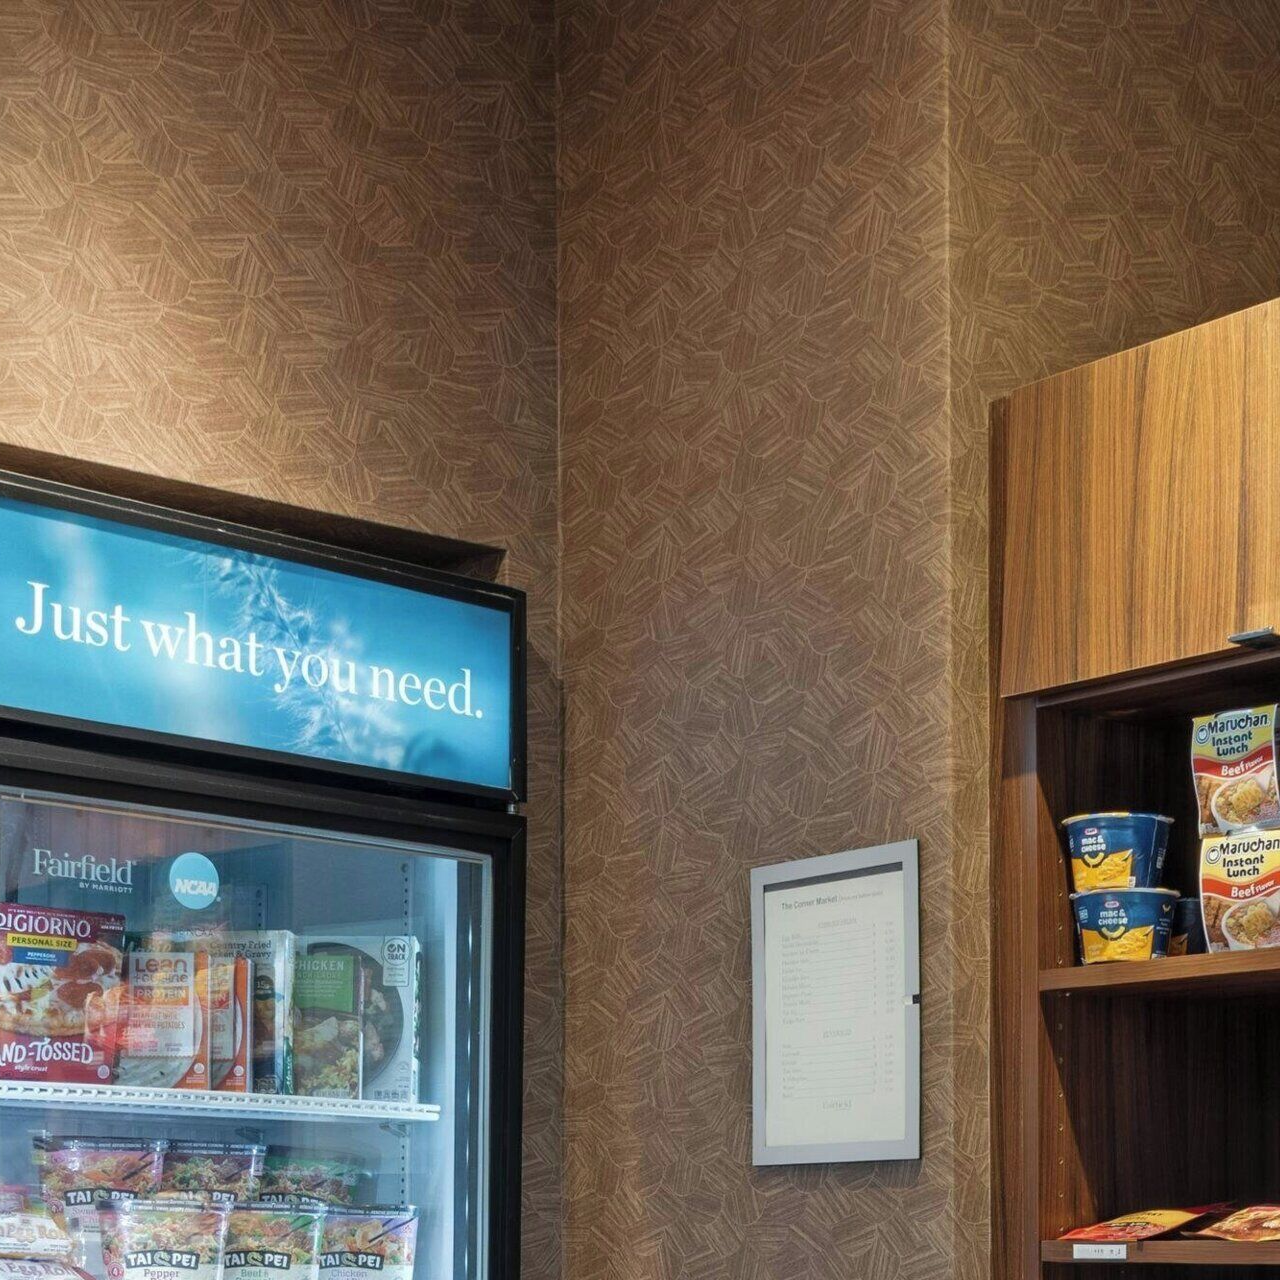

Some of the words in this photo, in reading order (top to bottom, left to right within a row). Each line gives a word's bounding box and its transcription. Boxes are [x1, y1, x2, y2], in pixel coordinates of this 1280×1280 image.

[15, 581, 130, 651] Just
[140, 612, 264, 675] what
[274, 648, 357, 693] you
[369, 666, 483, 718] need.
[1208, 712, 1270, 736] Maruchan
[1212, 732, 1253, 747] Instant
[1217, 742, 1249, 757] Lunch
[1221, 762, 1245, 777] Beef
[1220, 838, 1280, 858] Maruchan
[33, 848, 133, 885] Fairfield
[1222, 854, 1265, 868] Instant
[1227, 864, 1260, 878] Lunch
[92, 884, 133, 894] MARRIOTT
[175, 878, 217, 897] NCAA
[1230, 882, 1256, 898] Beef
[782, 901, 792, 910] The
[794, 898, 814, 909] Corner
[816, 895, 838, 906] Market
[11, 936, 53, 947] PERSONAL
[55, 939, 72, 948] SIZE
[135, 955, 187, 973] Lean
[70, 1191, 91, 1203] TAI
[128, 1253, 152, 1267] TAI
[172, 1254, 196, 1268] PEI
[224, 1253, 245, 1267] TAI
[264, 1253, 288, 1267] PEI
[320, 1254, 340, 1267] TAI
[358, 1254, 380, 1268] PEI
[144, 1269, 179, 1278] Pepper
[331, 1269, 368, 1278] Chicken
